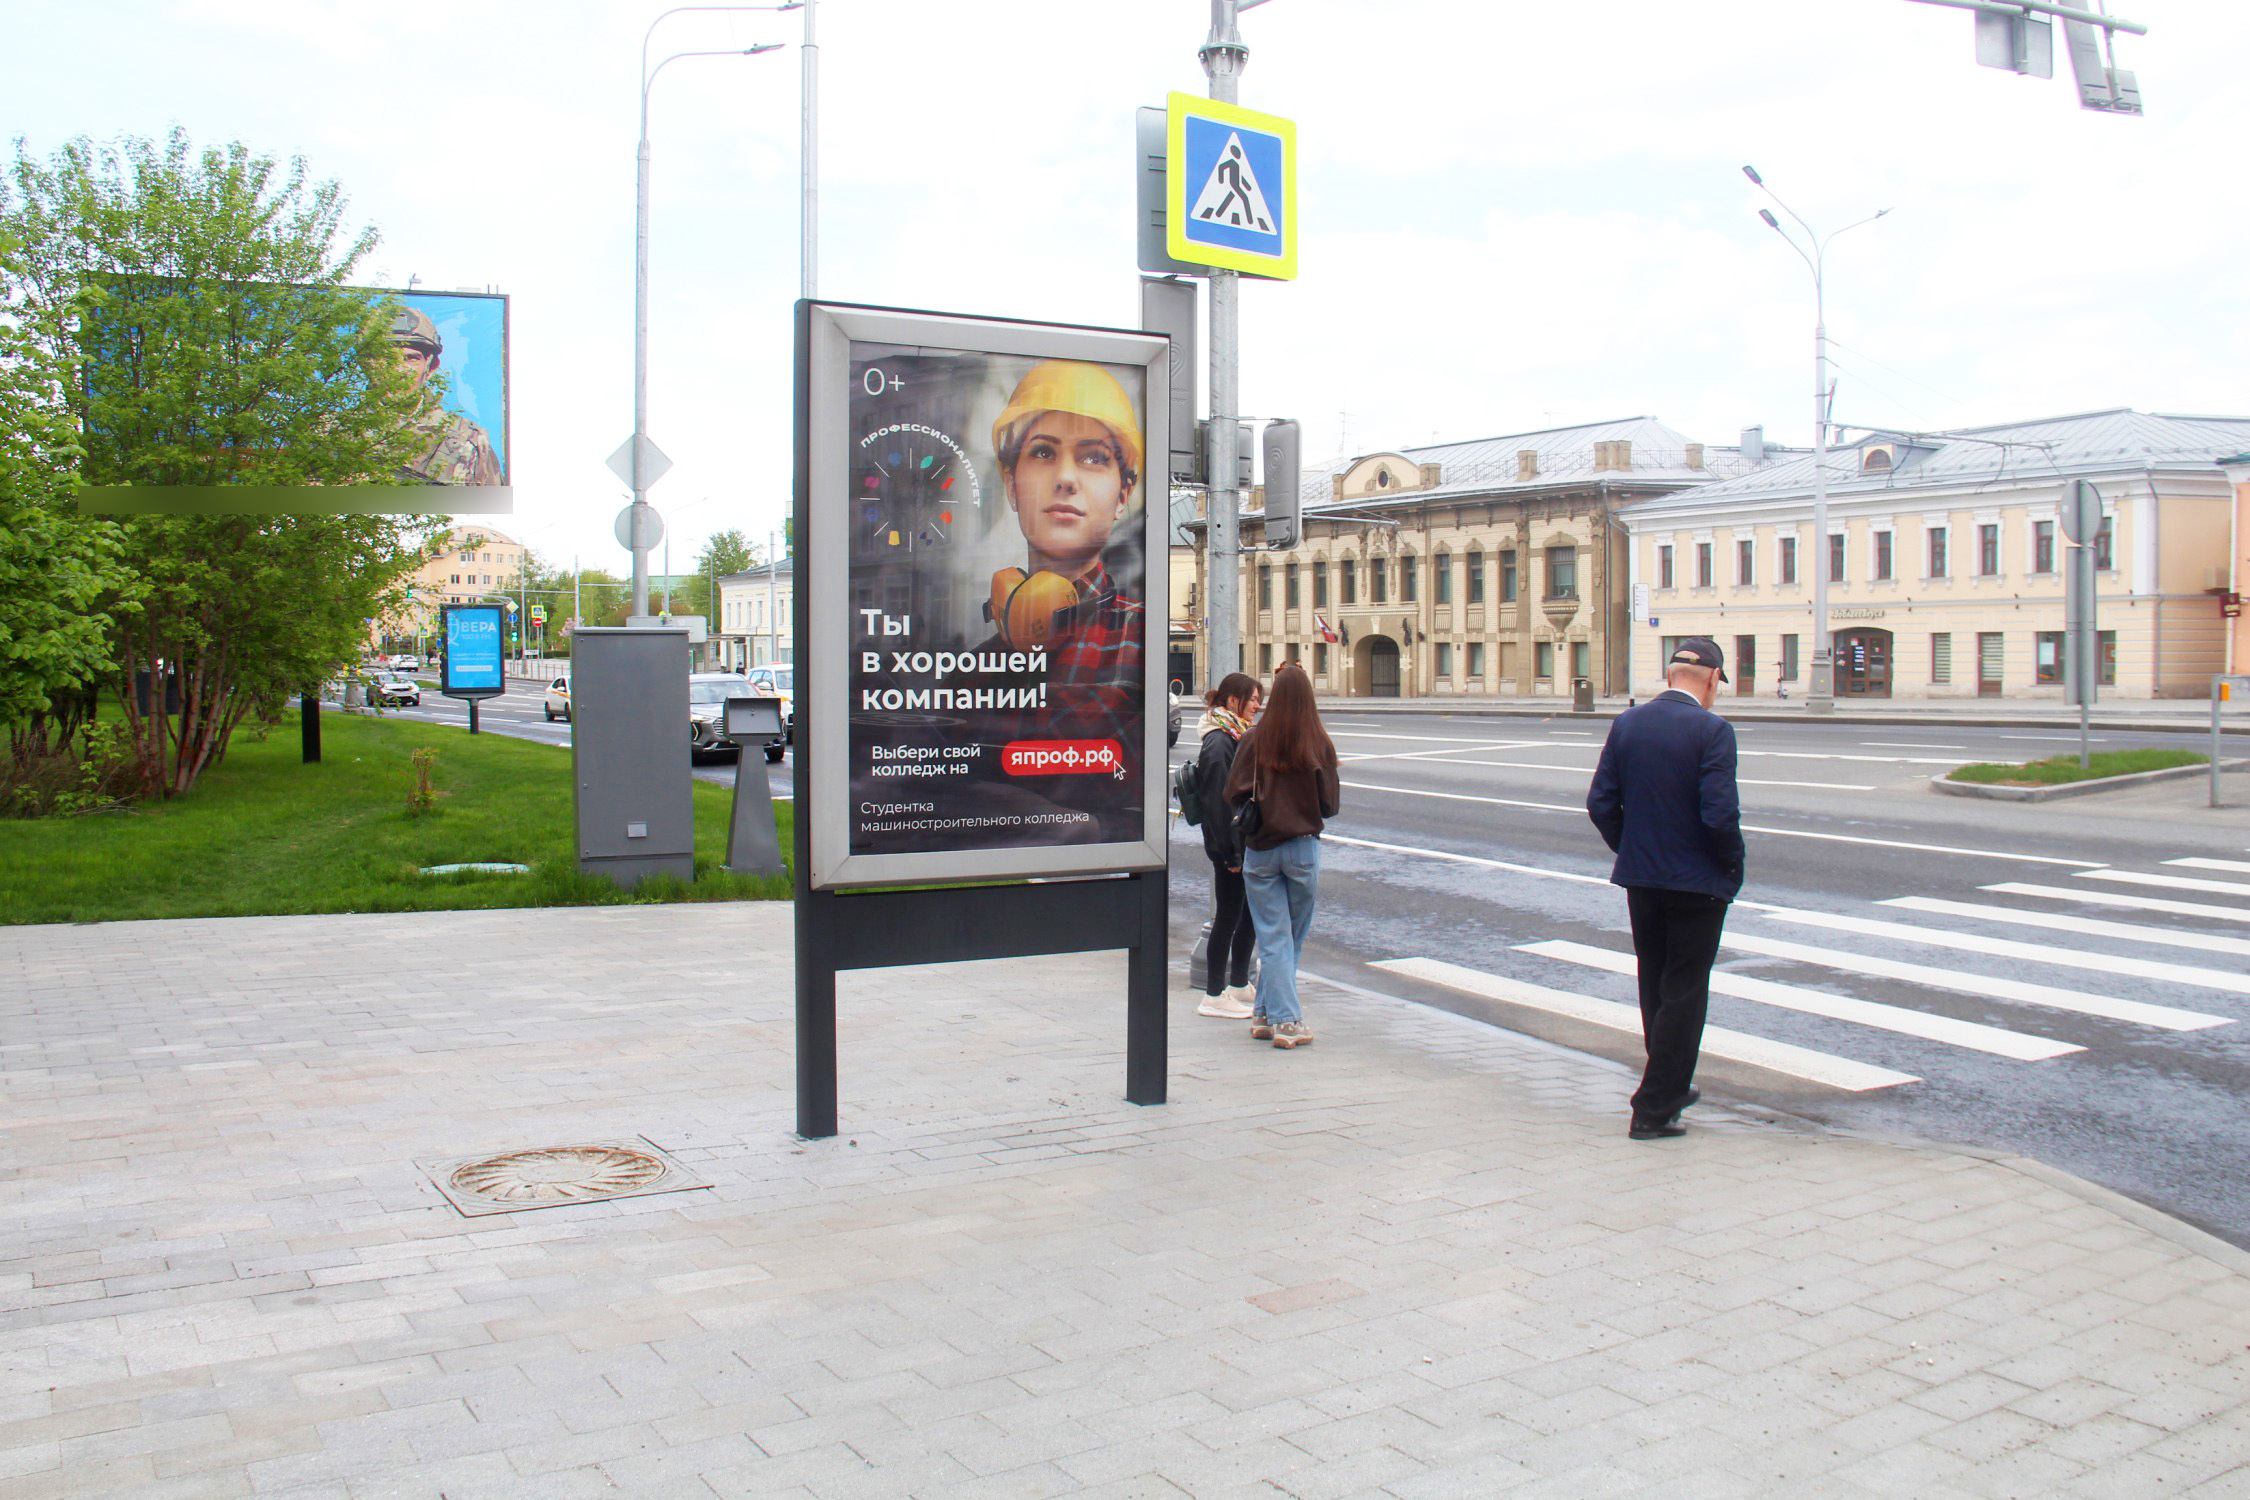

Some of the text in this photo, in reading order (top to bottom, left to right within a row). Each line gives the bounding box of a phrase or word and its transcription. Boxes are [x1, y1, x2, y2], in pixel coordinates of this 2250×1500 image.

[864, 368, 905, 396] 0+
[860, 423, 981, 508] ПРОФЕССИОНАЛИТЕТ
[461, 621, 497, 633] ВЕРА
[860, 608, 910, 636] Ты
[862, 645, 1047, 680] в хорошей
[862, 682, 1047, 711] компании!
[872, 743, 981, 761] Выбери свой
[1011, 746, 1114, 768] япроф.рф
[872, 761, 969, 776] колледж на
[861, 801, 934, 816] Студентка
[861, 811, 1090, 832] машиностроительного колледжа
